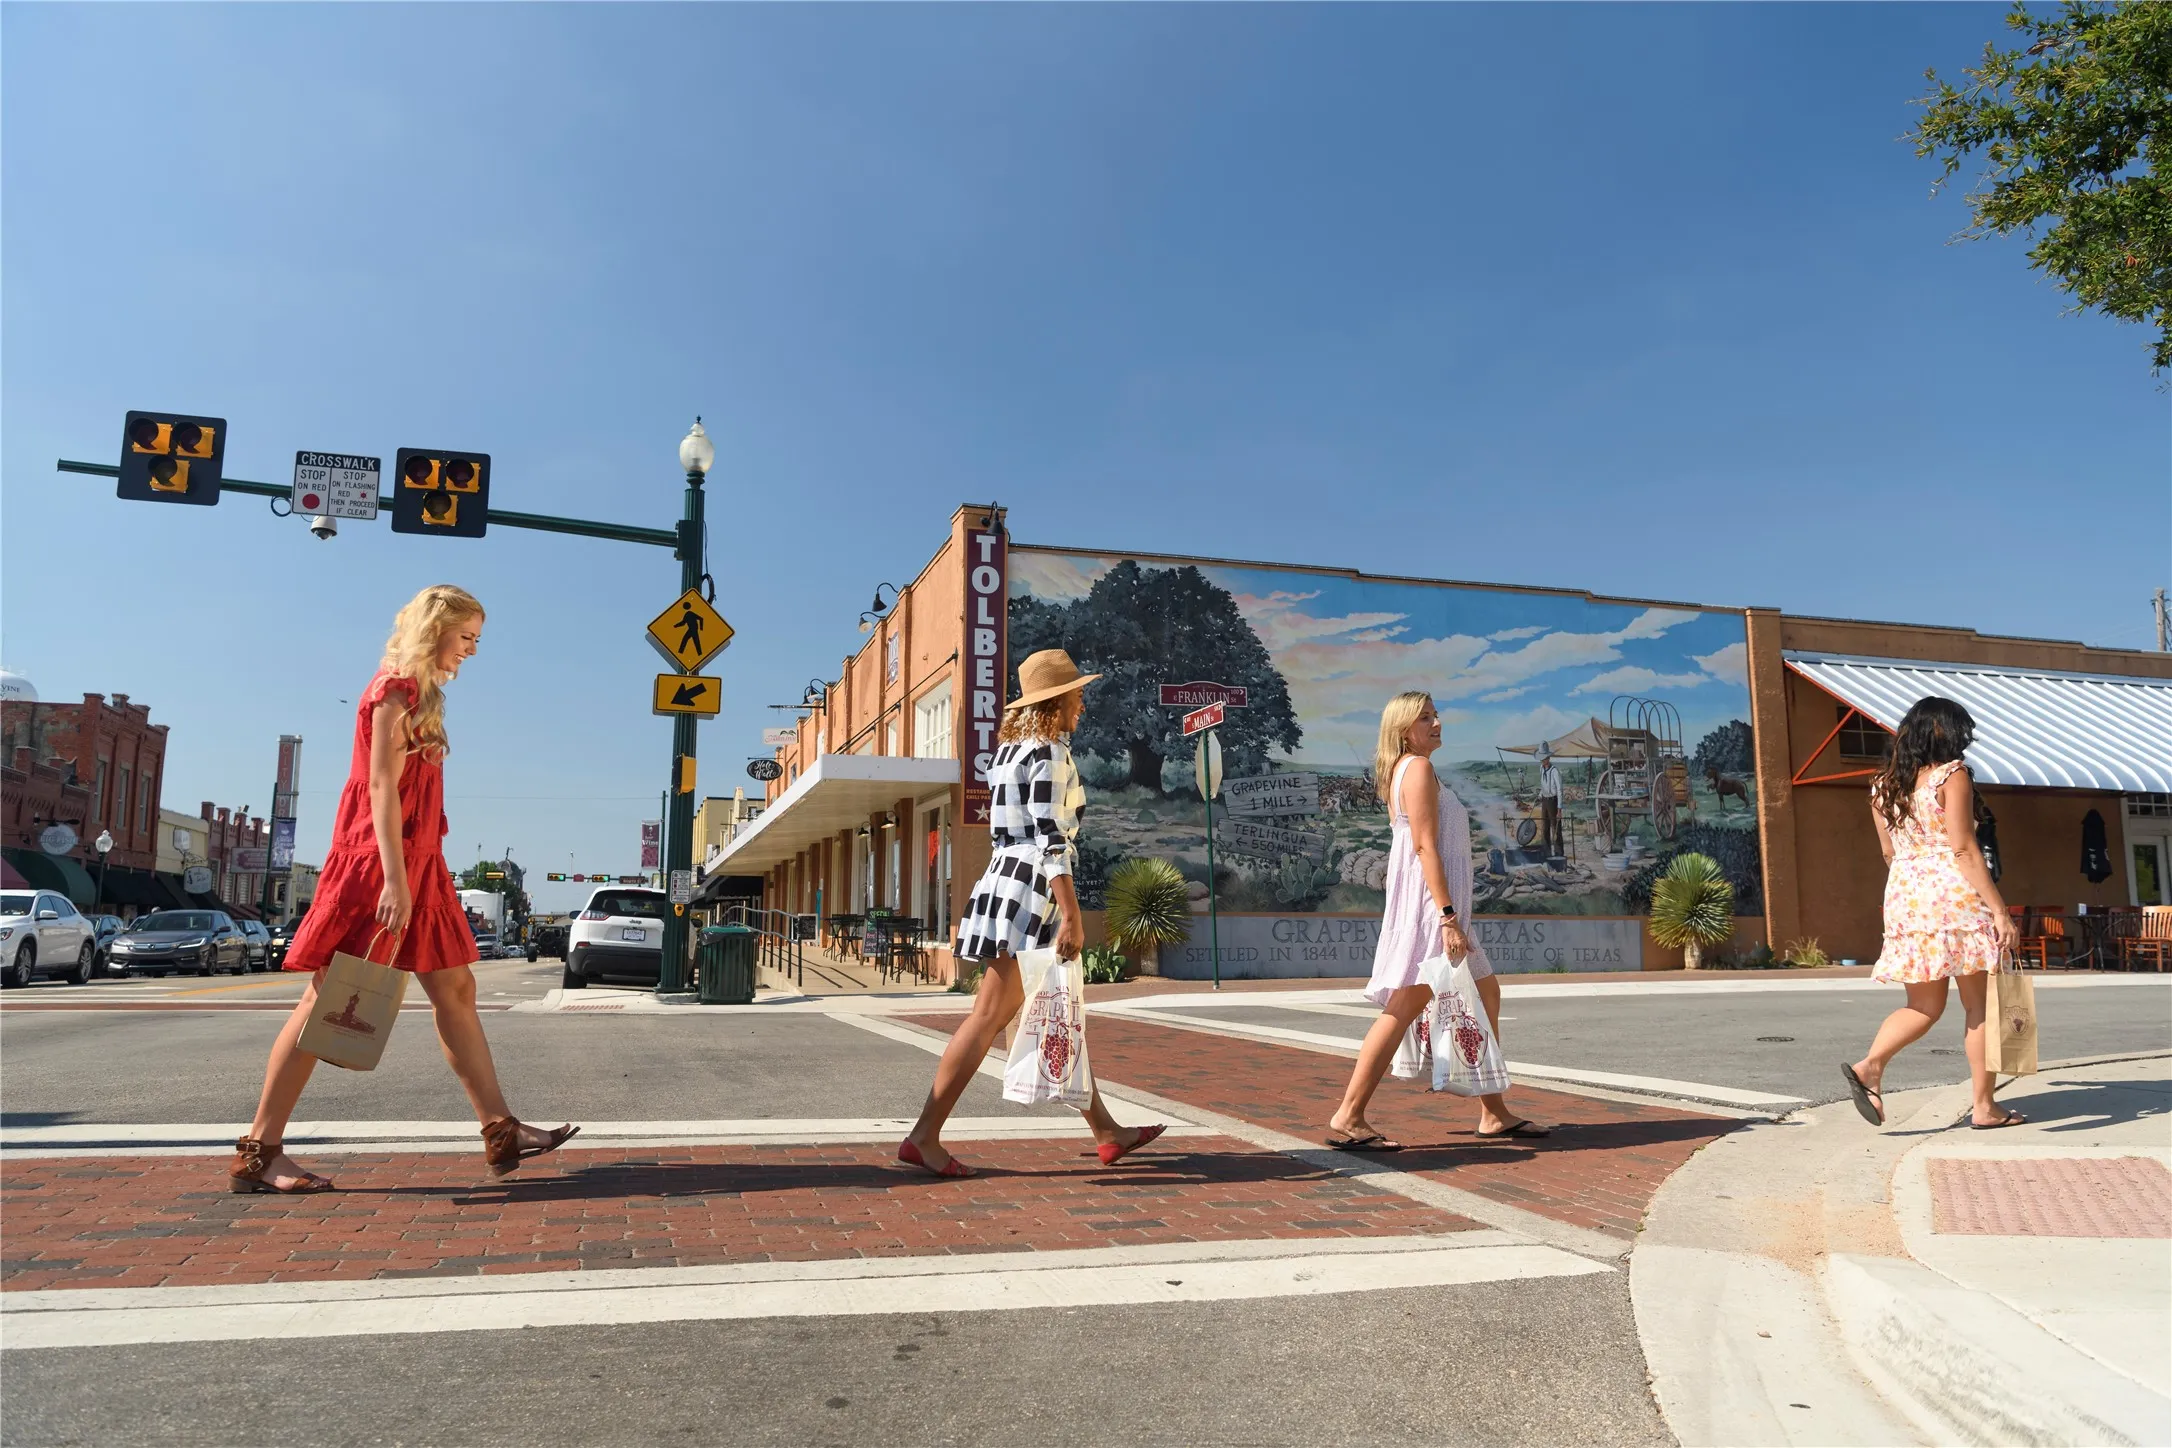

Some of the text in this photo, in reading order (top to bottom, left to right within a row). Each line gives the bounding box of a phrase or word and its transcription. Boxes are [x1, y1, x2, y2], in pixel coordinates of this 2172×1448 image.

[301, 453, 375, 471] CROSSWALK
[300, 469, 326, 480] STOP
[343, 471, 367, 481] STOP
[298, 482, 327, 492] ON RED
[332, 480, 376, 491] ON FLASHING
[337, 490, 351, 498] RED
[330, 498, 375, 509] THEN PROCEED
[347, 508, 368, 516] CLEAR
[971, 534, 1000, 782] TOLBERTS
[1178, 690, 1230, 704] FRANKLIN
[1194, 712, 1211, 730] MAIN
[281, 743, 289, 793] CITY
[1231, 777, 1301, 796] GRAPEVINE
[1250, 795, 1294, 810] 1 MILE
[1234, 823, 1307, 846] TERLINGUA
[1251, 840, 1305, 853] 550 MILES
[1272, 919, 1384, 944] GRAPEV
[1186, 947, 1259, 963] SETTLED
[1268, 946, 1292, 962] IN
[1302, 946, 1338, 961] 1844
[1482, 947, 1534, 961] PUBLIC
[1543, 947, 1564, 962] OF
[1572, 948, 1622, 962] TEXAS
